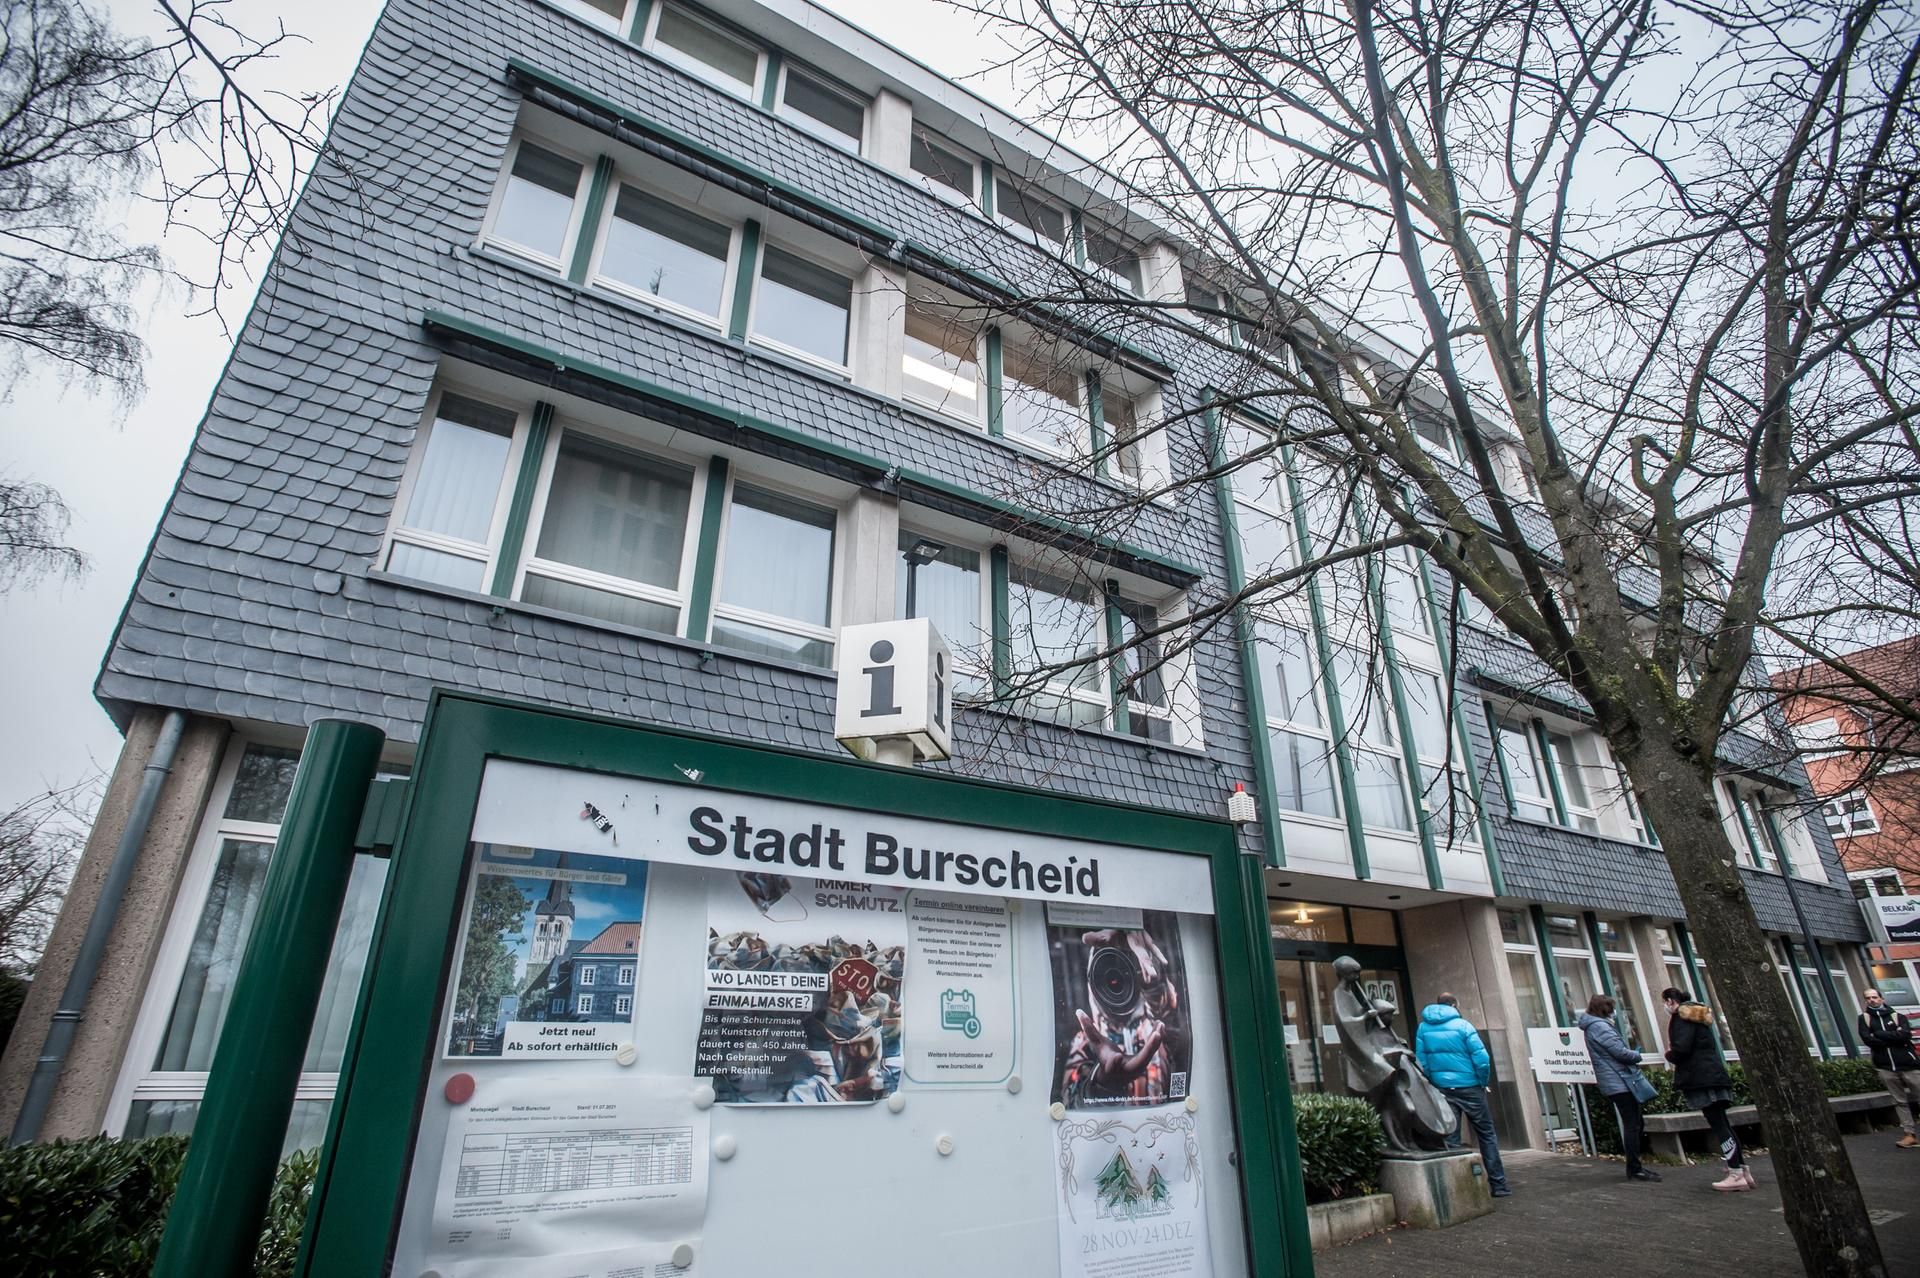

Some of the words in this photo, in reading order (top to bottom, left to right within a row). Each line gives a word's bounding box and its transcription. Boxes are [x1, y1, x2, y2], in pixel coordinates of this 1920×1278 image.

[687, 806, 846, 871] Stadt
[864, 831, 1101, 897] Burscheid
[487, 864, 543, 877] Wissenswertes
[559, 870, 585, 881] Bürger
[586, 873, 600, 881] und
[814, 877, 872, 894] IMMER
[814, 892, 903, 914] SCHMUTZ.
[914, 897, 939, 908] Termin
[941, 901, 963, 910] online
[965, 903, 1005, 914] vereinbaren
[1881, 904, 1916, 913] BELKAW
[711, 972, 733, 985] WO
[737, 973, 787, 987] LANDET
[791, 975, 826, 988] DEINE
[708, 994, 811, 1010] EINMALMASKE?
[945, 1002, 970, 1010] Termin
[704, 1015, 719, 1024] Bis
[721, 1016, 740, 1025] eine
[743, 1016, 802, 1026] Schutzmaske
[539, 1027, 568, 1036] Jetzt
[572, 1027, 596, 1036] neu!
[701, 1028, 718, 1036] aus
[721, 1028, 768, 1037] Kunststoff
[771, 1029, 808, 1039] verottet,
[508, 1042, 523, 1051] Ab
[527, 1042, 561, 1051] sofort
[564, 1042, 618, 1051] erhältlich
[700, 1040, 730, 1049] dauert
[762, 1041, 780, 1050] 450
[782, 1041, 809, 1051] Jahre.
[698, 1053, 723, 1062] Nach
[726, 1053, 769, 1062] Gebrauch
[1555, 1049, 1584, 1057] Rathaus
[697, 1066, 707, 1074] in
[710, 1066, 728, 1074] den
[731, 1066, 774, 1075] Restmüll.
